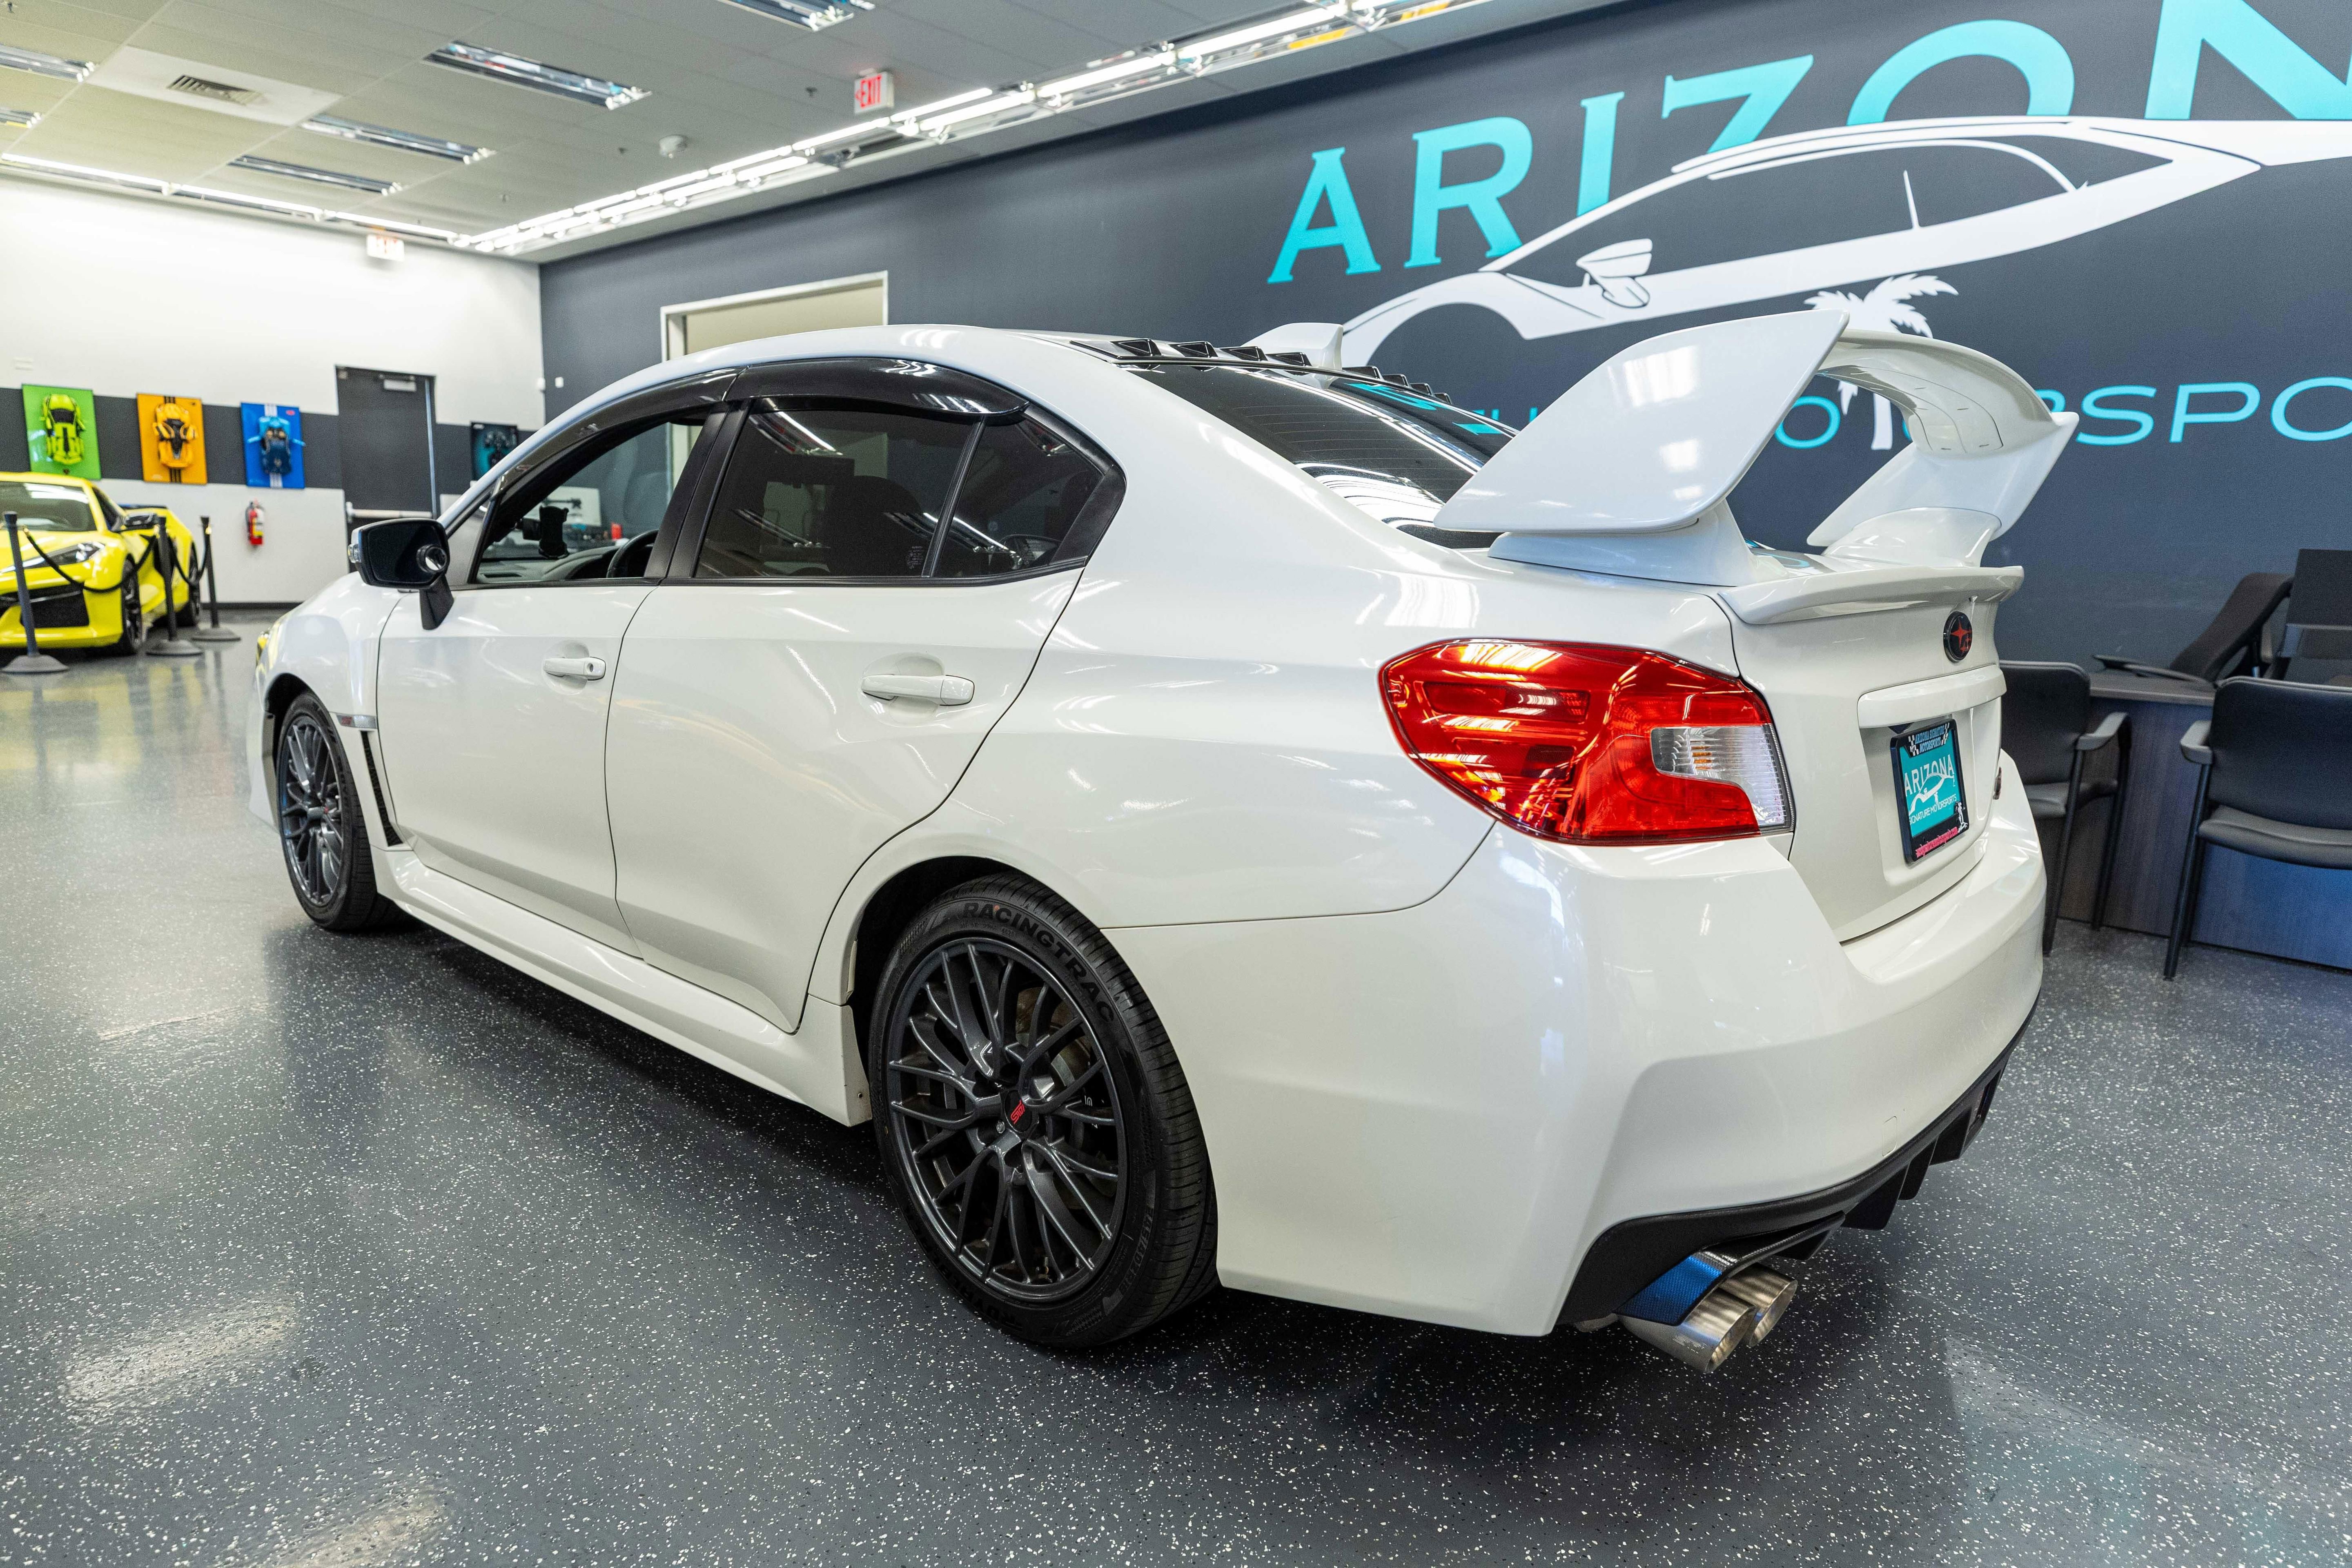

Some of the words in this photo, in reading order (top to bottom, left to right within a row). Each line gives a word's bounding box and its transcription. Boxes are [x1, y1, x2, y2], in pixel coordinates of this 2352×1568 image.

[860, 74, 882, 109] EXIT
[1915, 731, 1929, 744] ARIZONA
[1920, 737, 1941, 754] MOTORSPORTS
[1904, 754, 1955, 796] ARIZONA
[962, 902, 1115, 1022] RACINGTRAC
